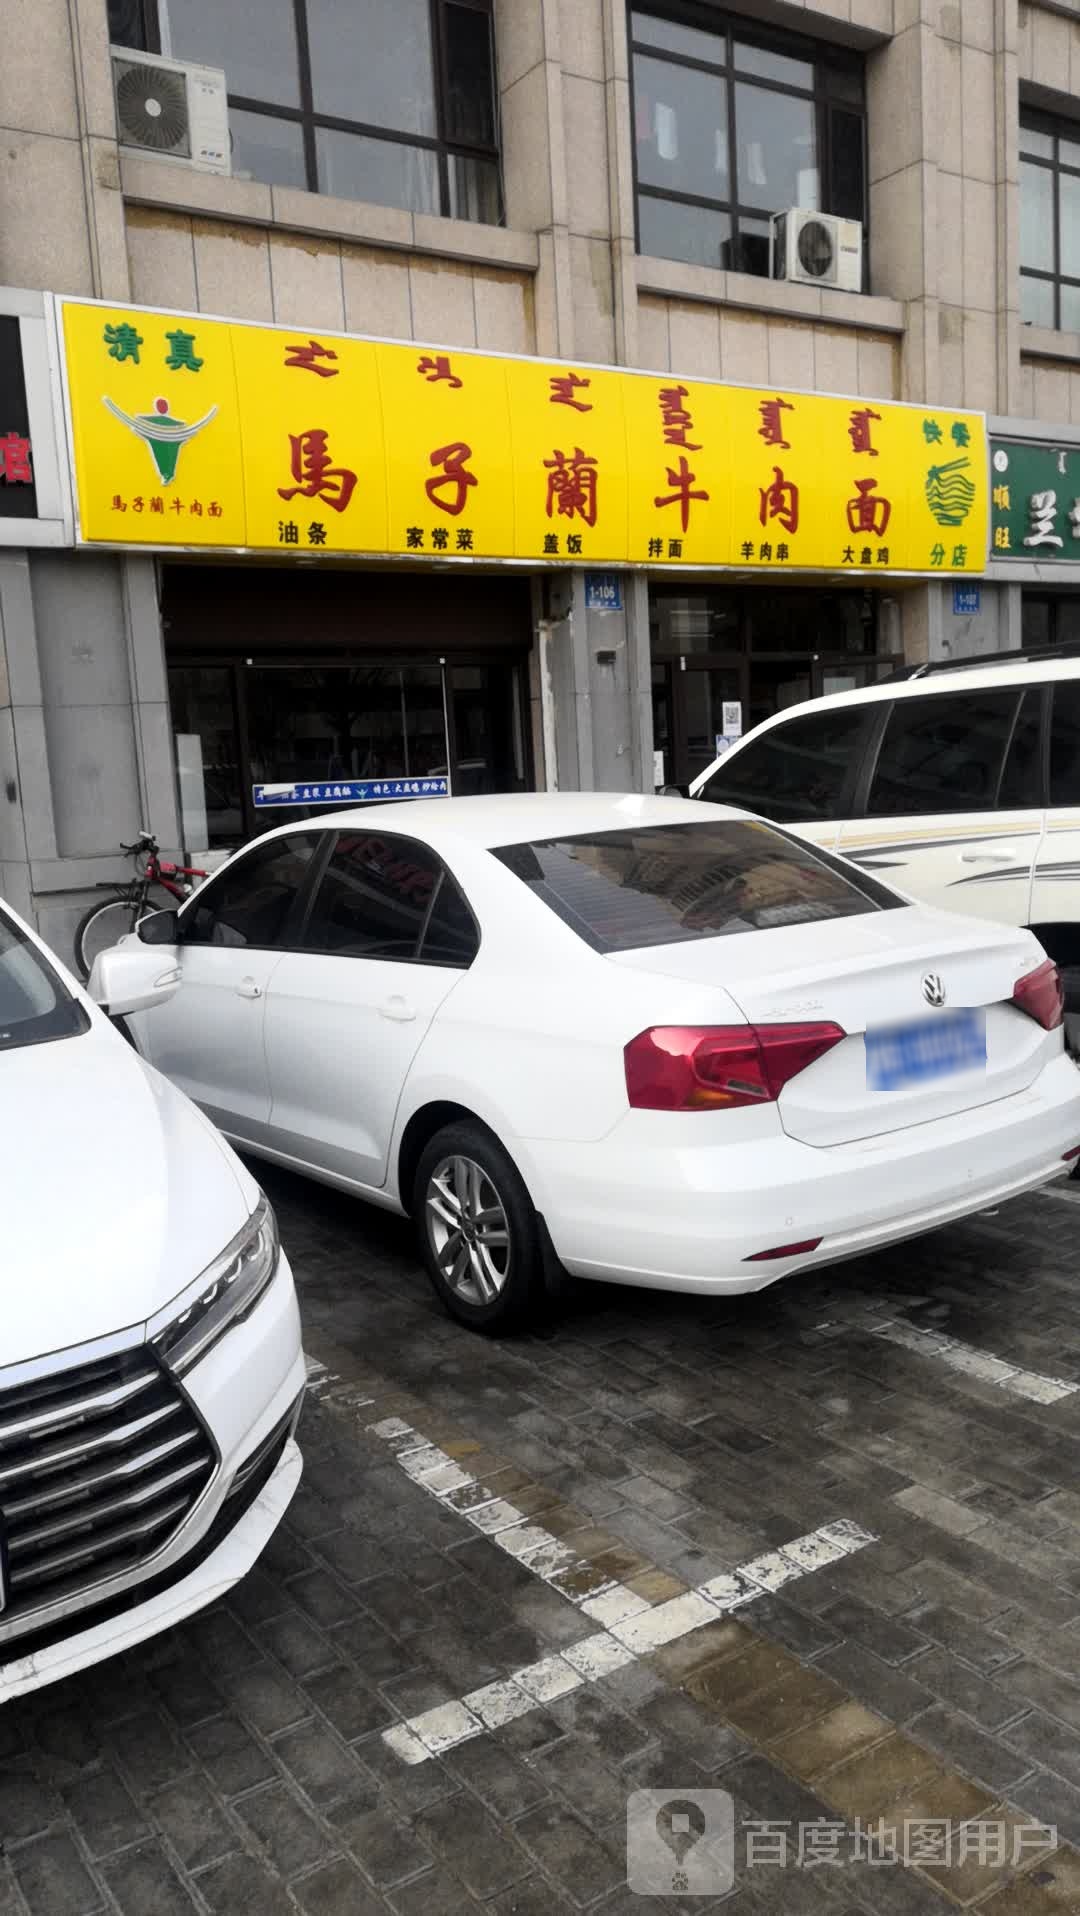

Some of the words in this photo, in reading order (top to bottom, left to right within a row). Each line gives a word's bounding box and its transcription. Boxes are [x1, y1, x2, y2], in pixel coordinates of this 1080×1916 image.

[104, 323, 202, 371] 清真
[924, 420, 970, 447] 快餐
[279, 521, 328, 545] 油条
[406, 527, 474, 550] 家常菜
[543, 534, 583, 555] 盖饭
[648, 538, 684, 559] 拌面
[741, 542, 790, 562] 羊肉串
[842, 546, 890, 566] 大盘鸡
[930, 543, 967, 566] 分店
